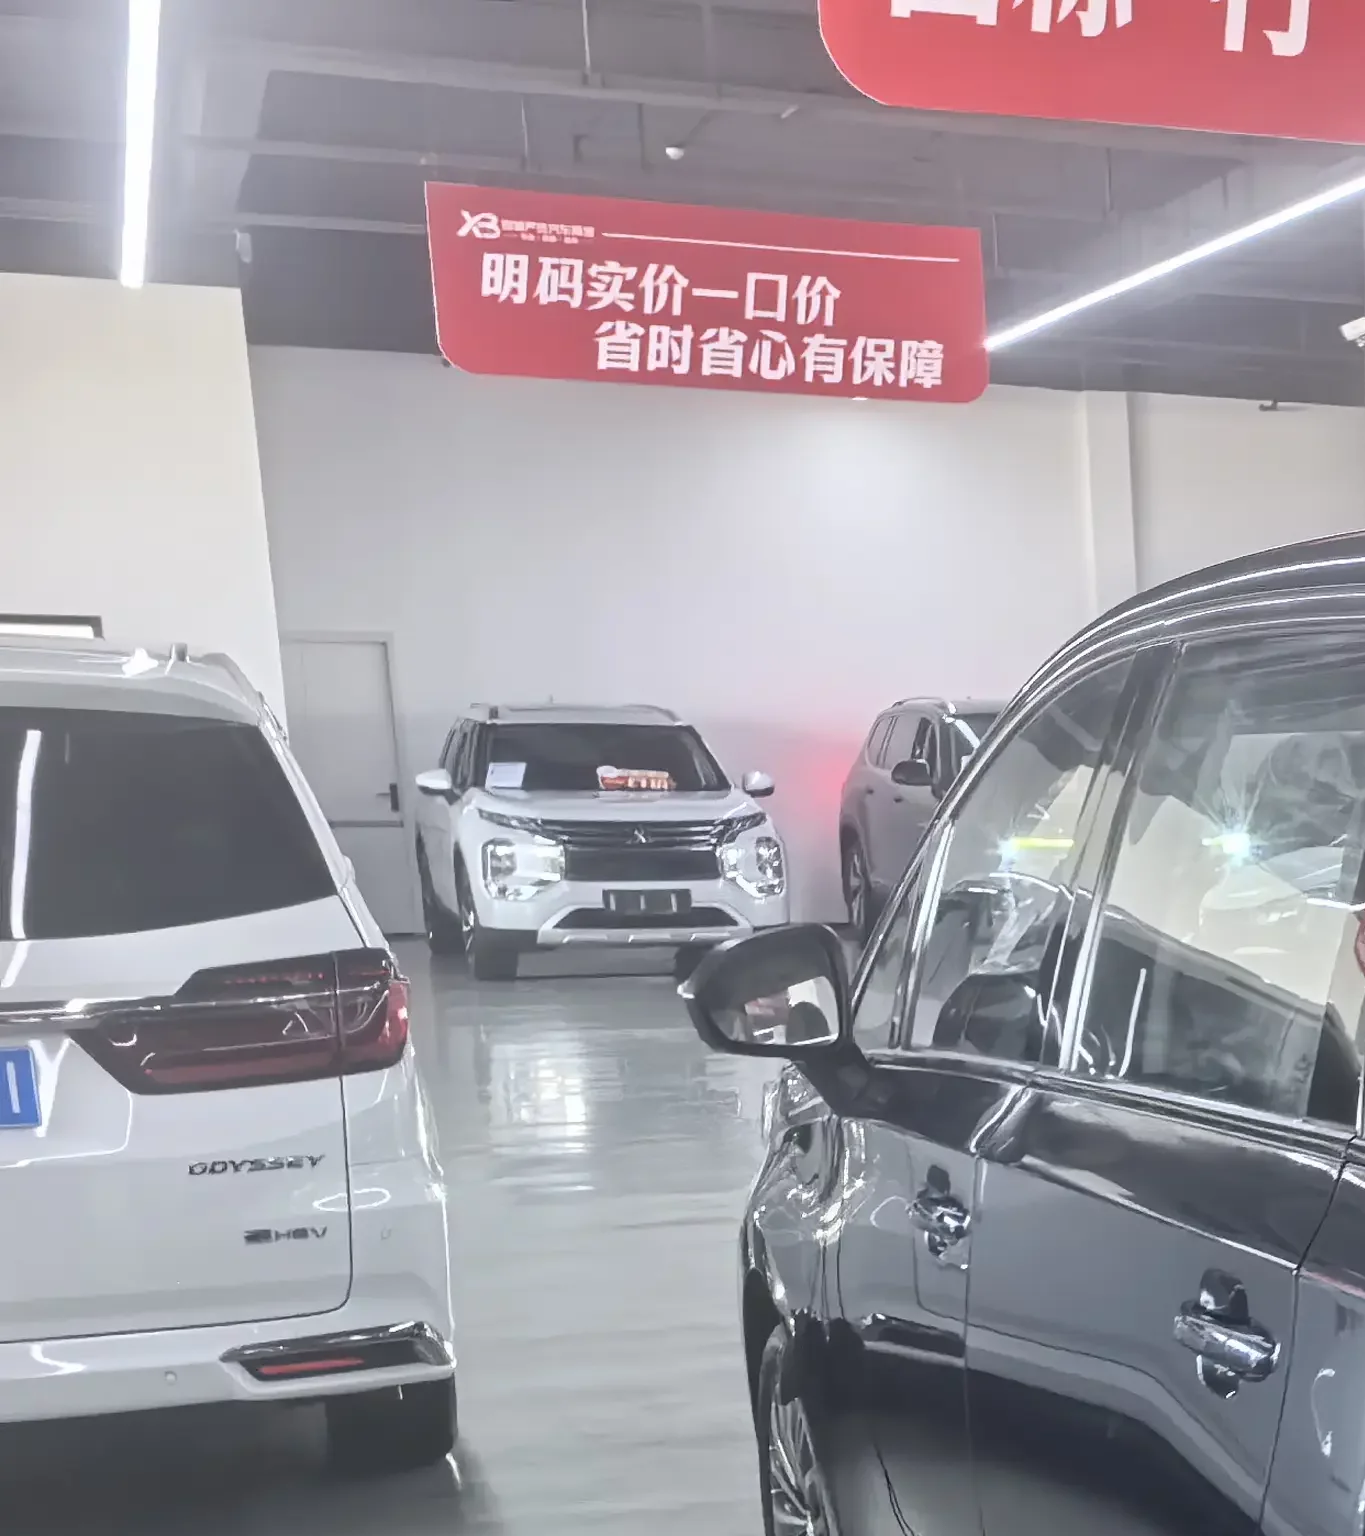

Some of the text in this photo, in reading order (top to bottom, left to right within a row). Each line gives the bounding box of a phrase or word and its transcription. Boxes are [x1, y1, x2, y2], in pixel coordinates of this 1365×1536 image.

[481, 252, 842, 327] 明码实价一口价
[594, 320, 944, 388] 省时省心有保障
[187, 1152, 326, 1177] ODYSSEY
